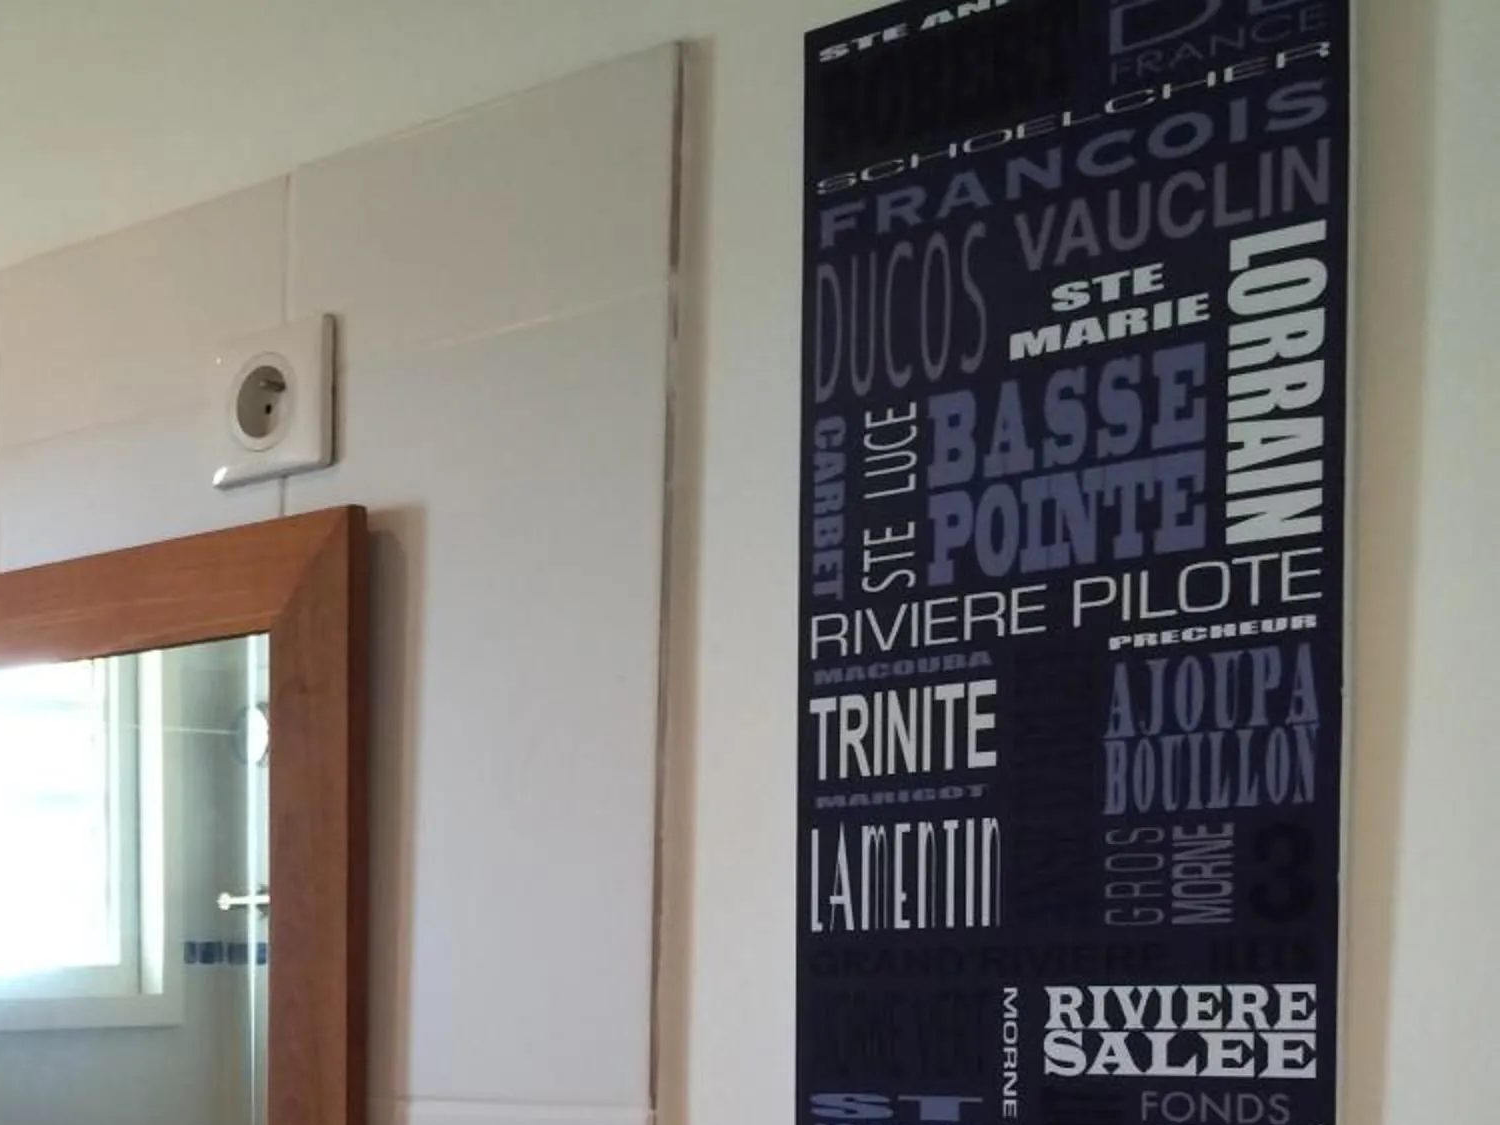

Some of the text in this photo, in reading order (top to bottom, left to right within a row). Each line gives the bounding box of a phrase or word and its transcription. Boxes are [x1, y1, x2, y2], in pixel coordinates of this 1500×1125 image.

[819, 23, 907, 62] STE
[1110, 4, 1327, 84] FRANCE
[817, 42, 1330, 195] SCHOELCHER
[820, 80, 1329, 249] FRANCOIS
[1015, 138, 1330, 271] VAUCLIN
[815, 222, 987, 403] DUCOS
[1009, 293, 1210, 361] MARIE
[1051, 263, 1164, 312] STE
[927, 342, 1206, 488] BASSE
[1226, 219, 1328, 545] LORRAIN
[812, 415, 846, 600] CARBET
[862, 402, 917, 593] STE LUCE
[927, 449, 1207, 587] POINTE
[811, 548, 1323, 660] RIVIERE PILOTE
[1108, 614, 1317, 651] PRECHEUR
[814, 651, 992, 685] MACOUBA
[1104, 643, 1320, 739] AJOUPA
[810, 680, 997, 780] TRINITE
[1102, 724, 1318, 816] BOUILLON
[815, 784, 988, 808] MARIGOT
[810, 817, 1000, 933] LAMENTIN
[1105, 827, 1165, 927] GROS
[1172, 824, 1234, 924] MORNE
[1001, 987, 1018, 1120] MORNE
[1044, 984, 1317, 1031] RIVIERE
[1044, 1031, 1317, 1079] SALEE
[811, 1093, 983, 1121] ST
[1141, 1091, 1290, 1125] FONDS
